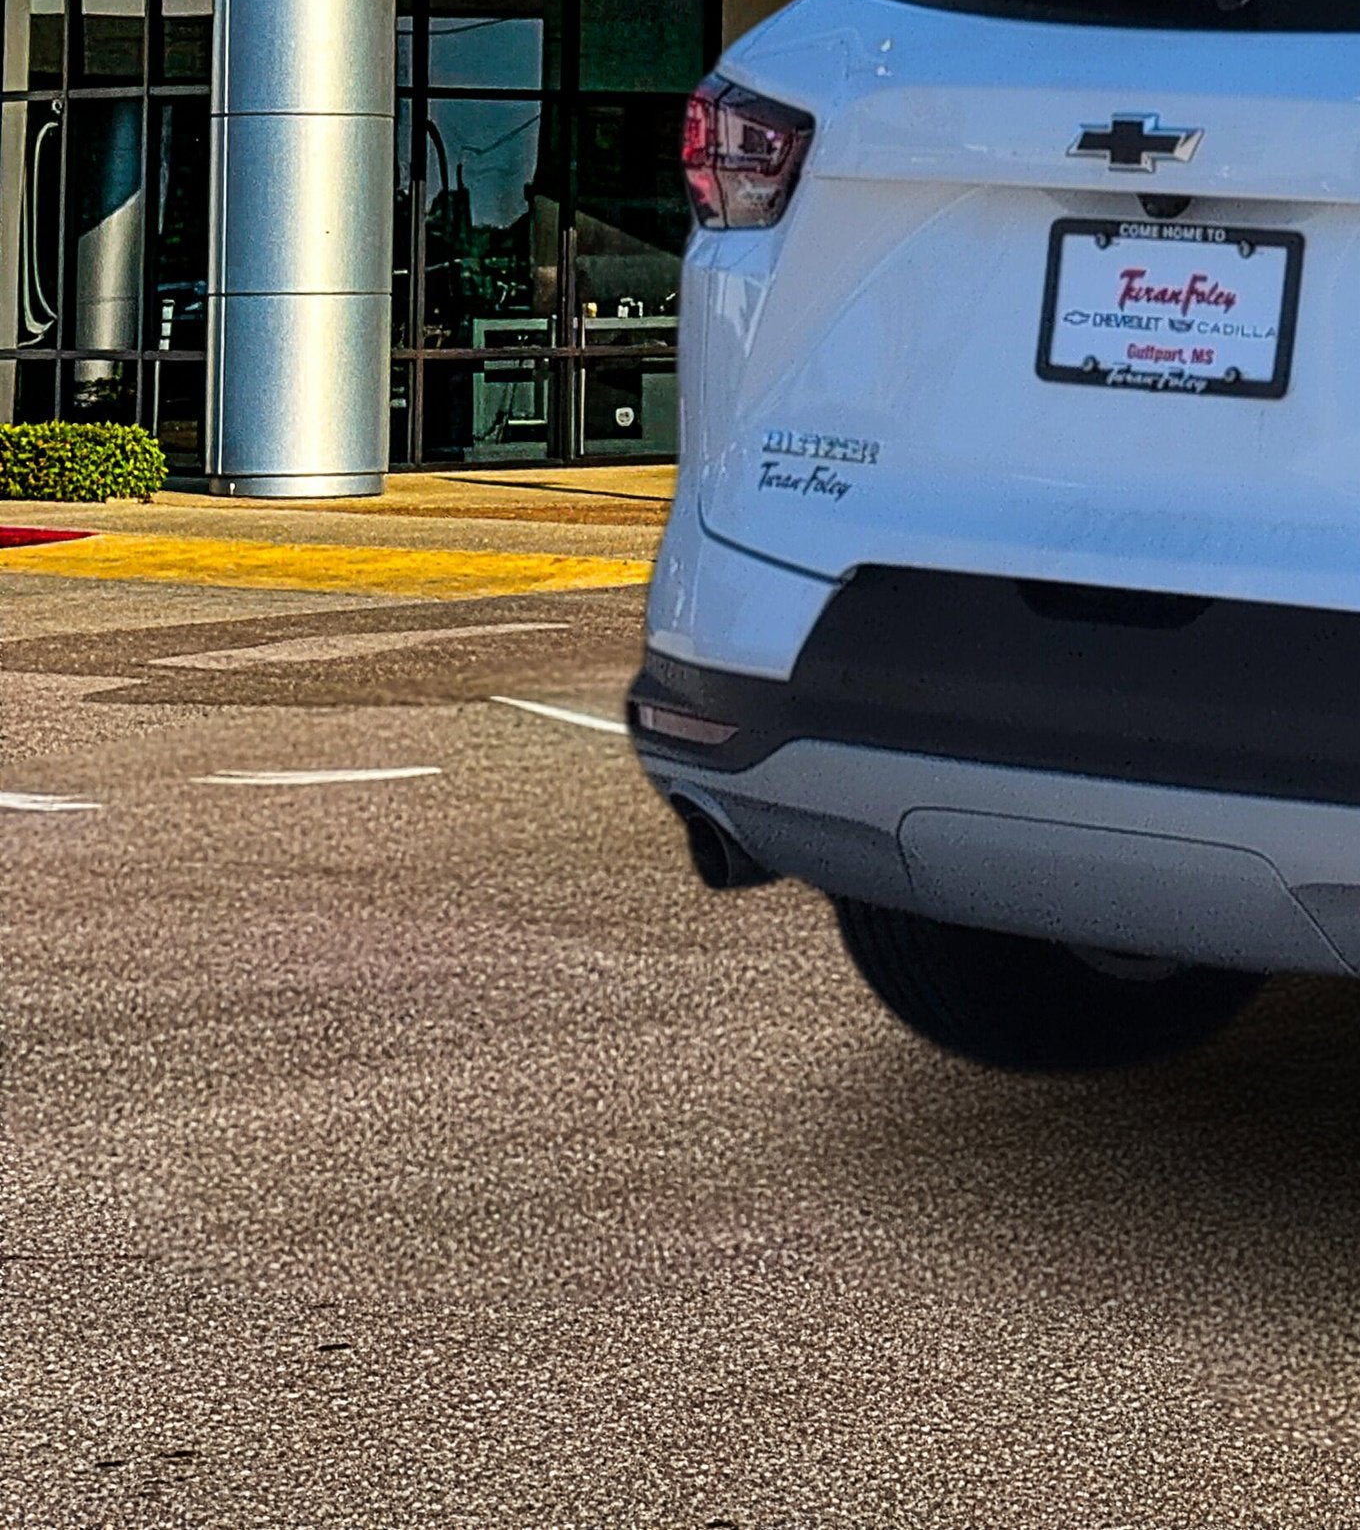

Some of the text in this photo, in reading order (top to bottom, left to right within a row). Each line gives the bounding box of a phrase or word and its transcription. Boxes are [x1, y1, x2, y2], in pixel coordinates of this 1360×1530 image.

[1119, 222, 1227, 243] COME HOME TO
[1092, 313, 1277, 339] CHEVROLET CADILLA
[1190, 347, 1215, 366] MS
